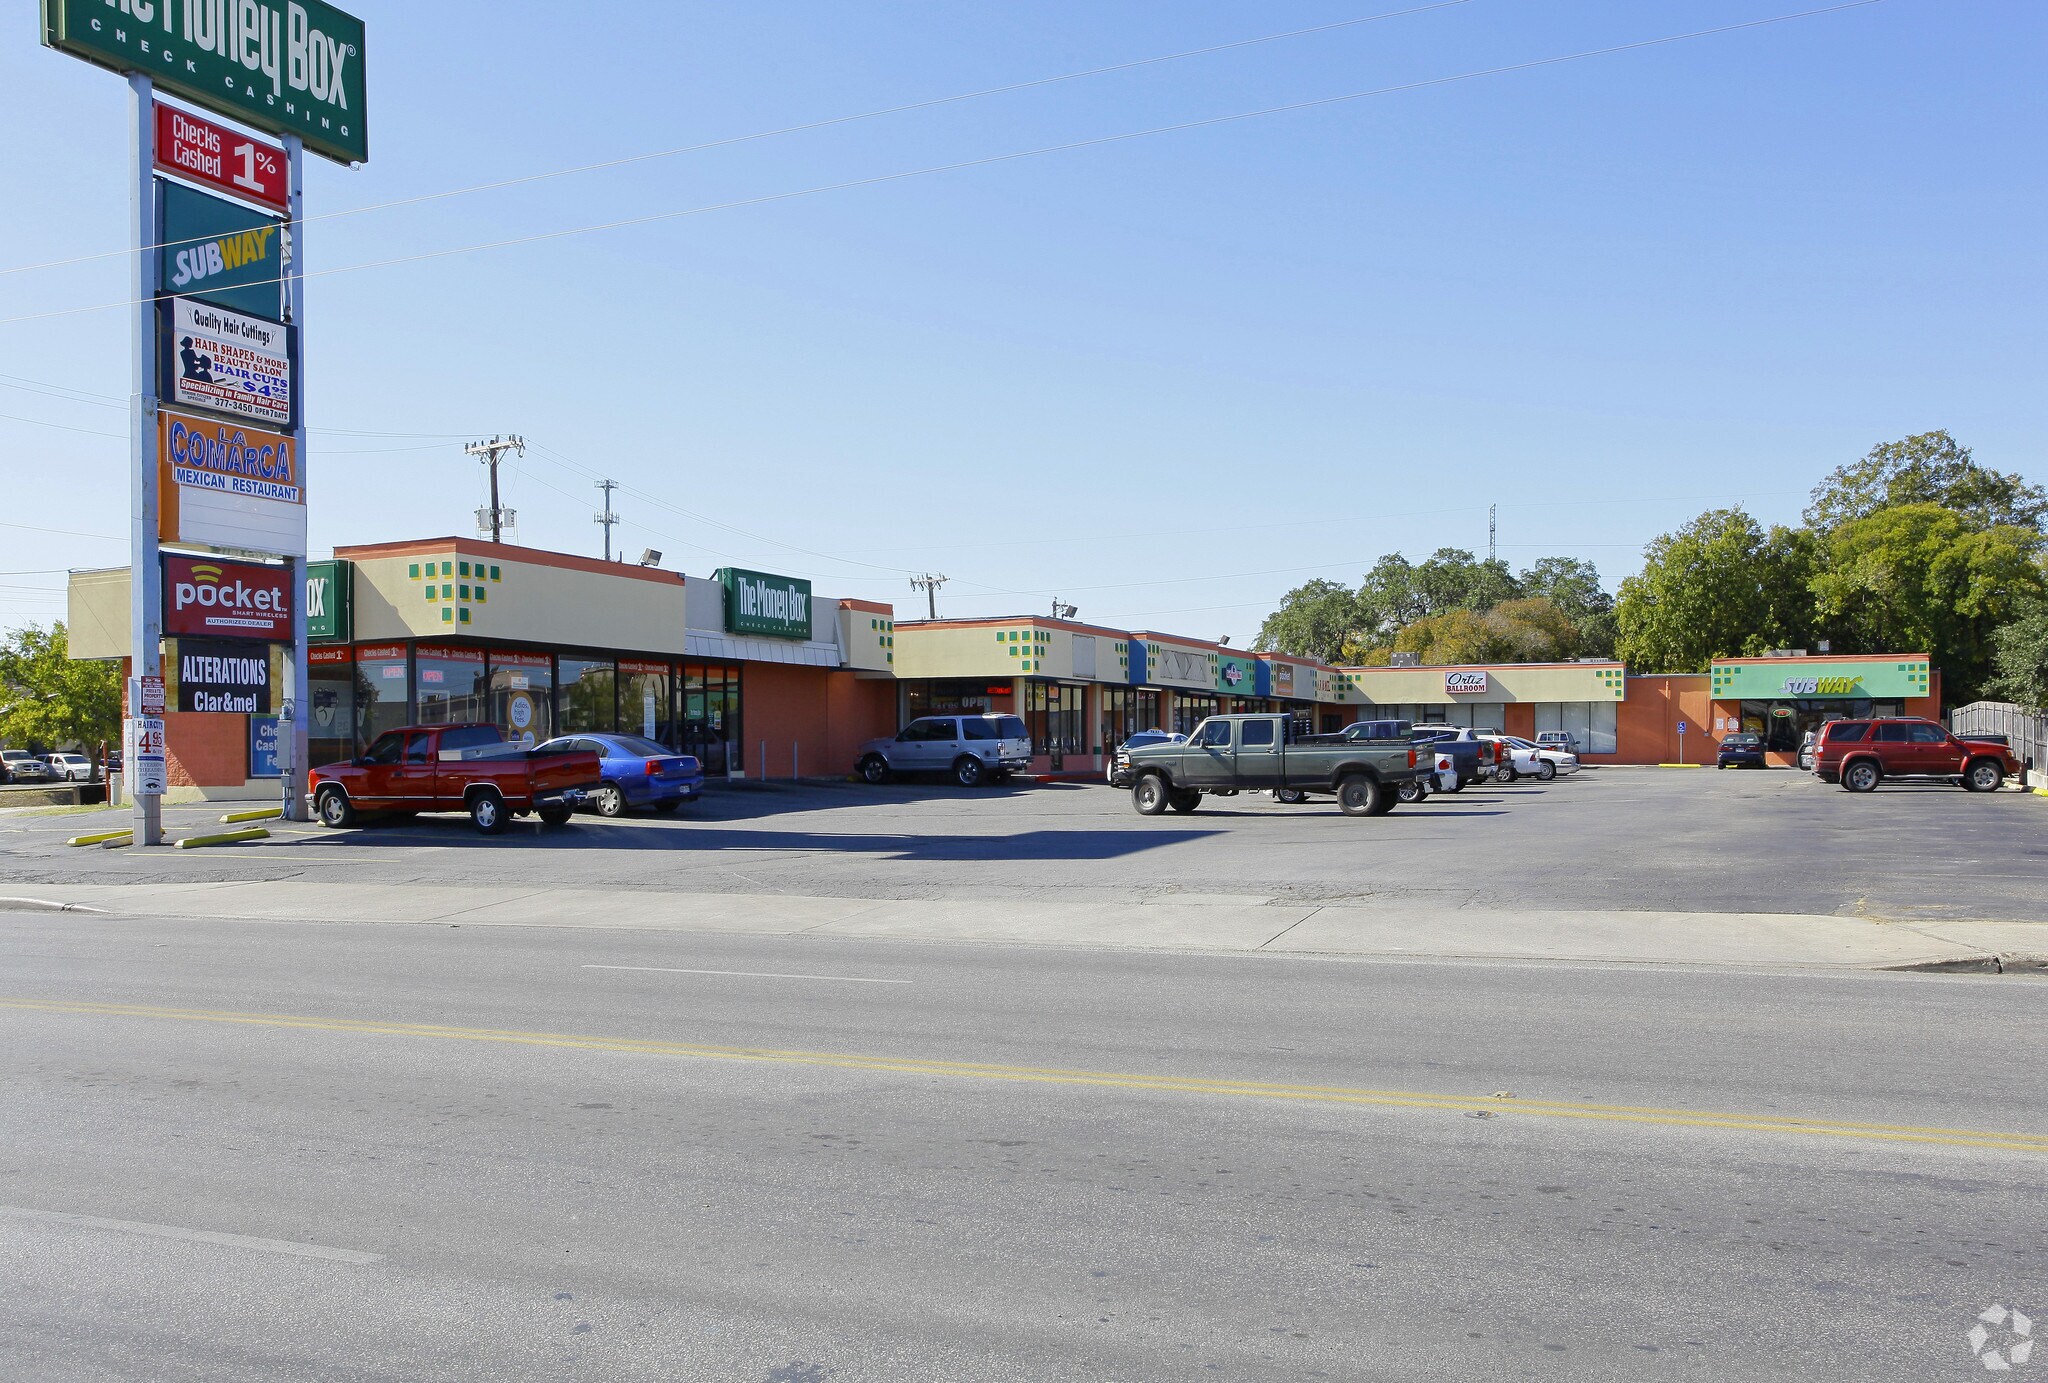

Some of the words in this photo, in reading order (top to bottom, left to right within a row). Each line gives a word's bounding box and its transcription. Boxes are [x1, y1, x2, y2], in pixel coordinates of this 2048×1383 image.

[91, 19, 196, 73] CHECK
[225, 77, 348, 136] CASHING
[173, 114, 220, 153] Checks
[174, 140, 220, 178] Cashed
[233, 142, 276, 193] 1%
[172, 223, 275, 287] SUBWAY
[194, 309, 221, 334] Quality
[223, 317, 239, 335] Hair
[241, 322, 270, 346] Cuttings
[195, 338, 218, 353] HAIR
[221, 344, 254, 361] SHAPES
[265, 358, 288, 369] MORE
[214, 354, 251, 370] BEAUTY
[253, 364, 282, 377] SALON
[214, 363, 250, 379] HAIR
[253, 373, 288, 388] CUTS
[181, 379, 225, 396] Specializing
[234, 391, 255, 404] Family
[257, 396, 271, 405] Hair
[272, 400, 288, 410] Care
[215, 398, 252, 413] 377-3450
[255, 406, 269, 415] OPEN
[270, 409, 274, 417] 7
[274, 411, 288, 420] DAYS
[170, 421, 292, 481] COMARCA
[219, 428, 247, 446] LA
[177, 468, 225, 488] MEXICAN
[233, 478, 297, 500] RESTAURANT
[176, 580, 281, 610] pocket
[307, 578, 325, 618] ox
[738, 577, 756, 616] The
[757, 580, 788, 626] Money
[789, 585, 806, 622] Box
[207, 618, 247, 626] AUTHORIZED
[182, 655, 265, 686] ALTERATIONS
[384, 668, 404, 677] OPEN
[423, 671, 443, 681] OPEN
[1448, 673, 1483, 685] Ortiz
[1778, 675, 1863, 695] SUBWAY
[194, 691, 256, 712] Clar&mel
